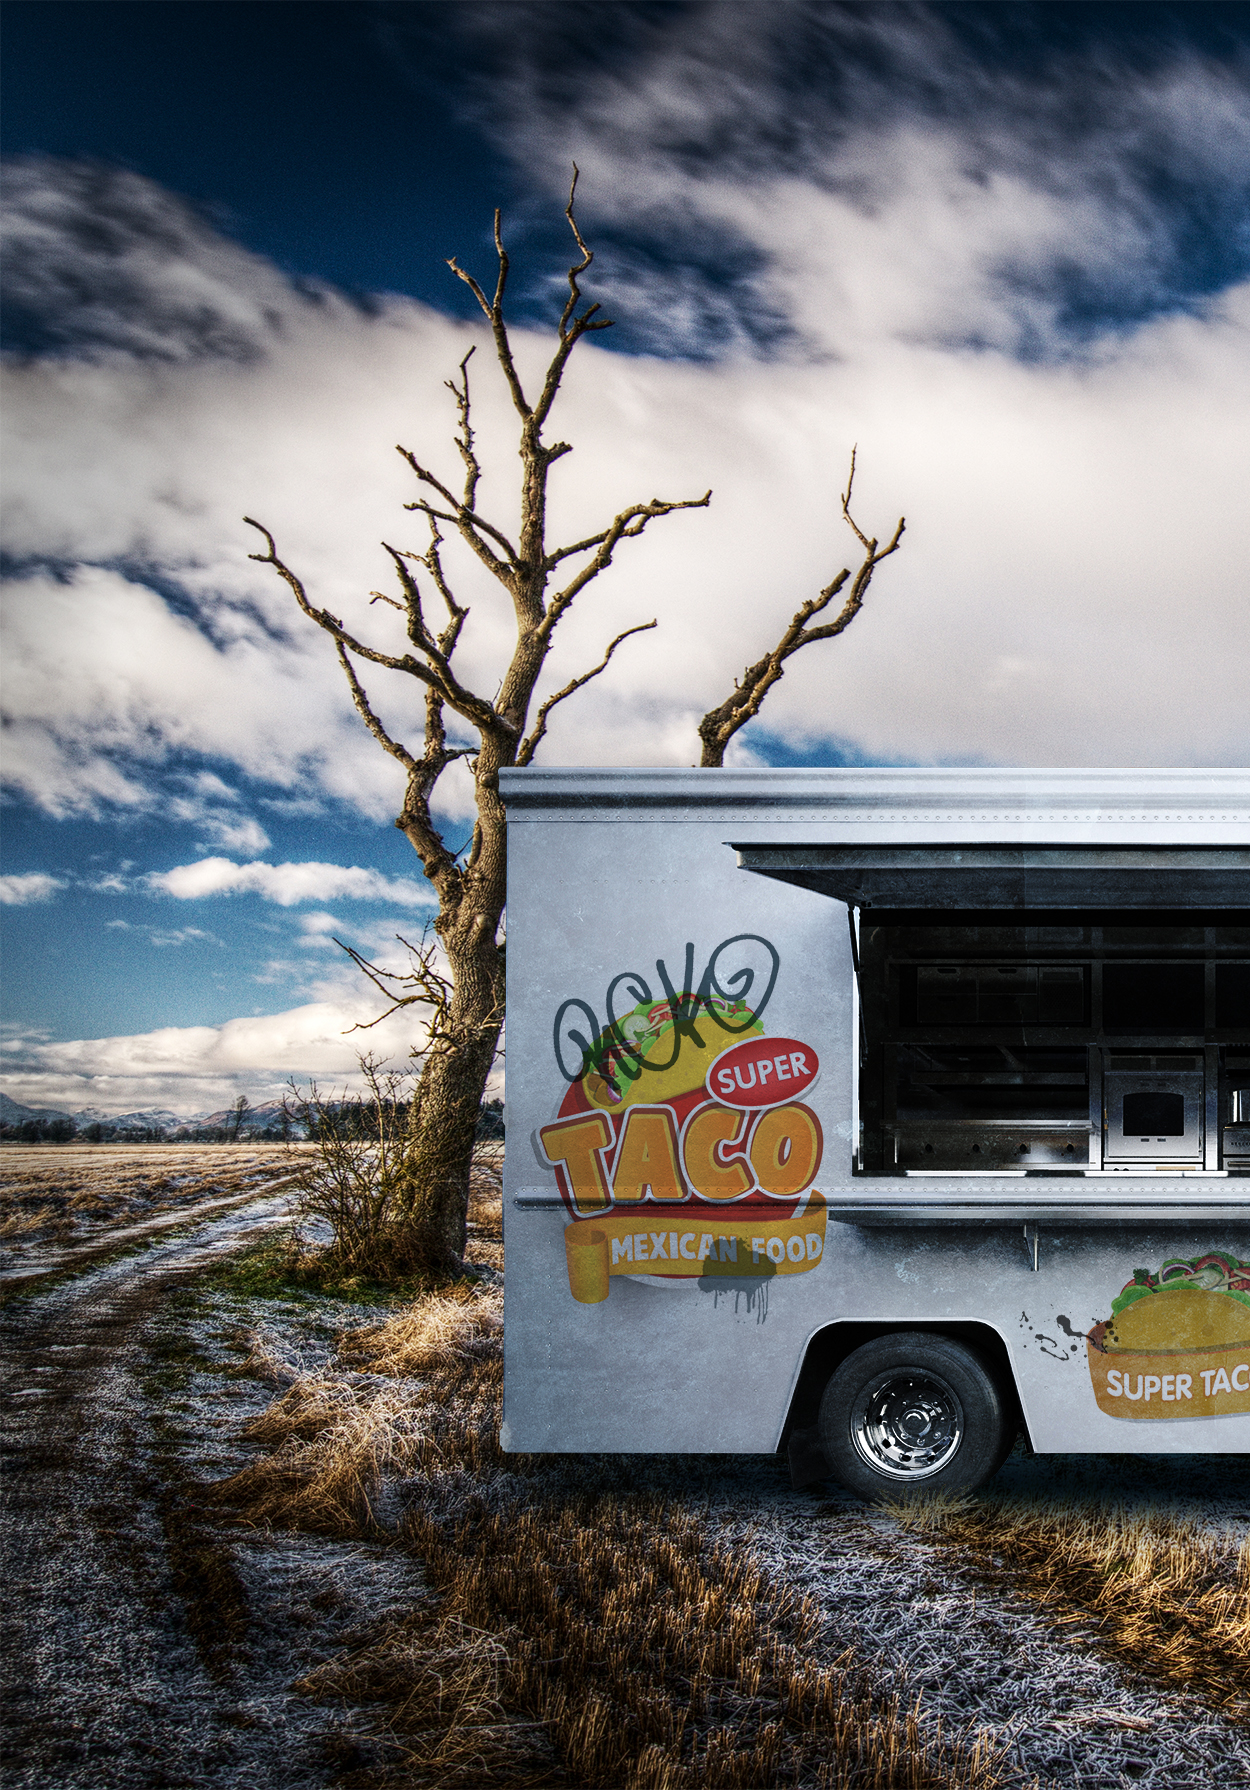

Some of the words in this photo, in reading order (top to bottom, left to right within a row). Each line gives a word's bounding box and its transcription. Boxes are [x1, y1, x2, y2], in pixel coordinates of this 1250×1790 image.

[717, 1051, 812, 1094] SUPER
[538, 1101, 823, 1218] TACO
[611, 1231, 738, 1265] MEXICAN
[751, 1232, 823, 1264] FOOD
[1106, 1369, 1193, 1401] SUPER
